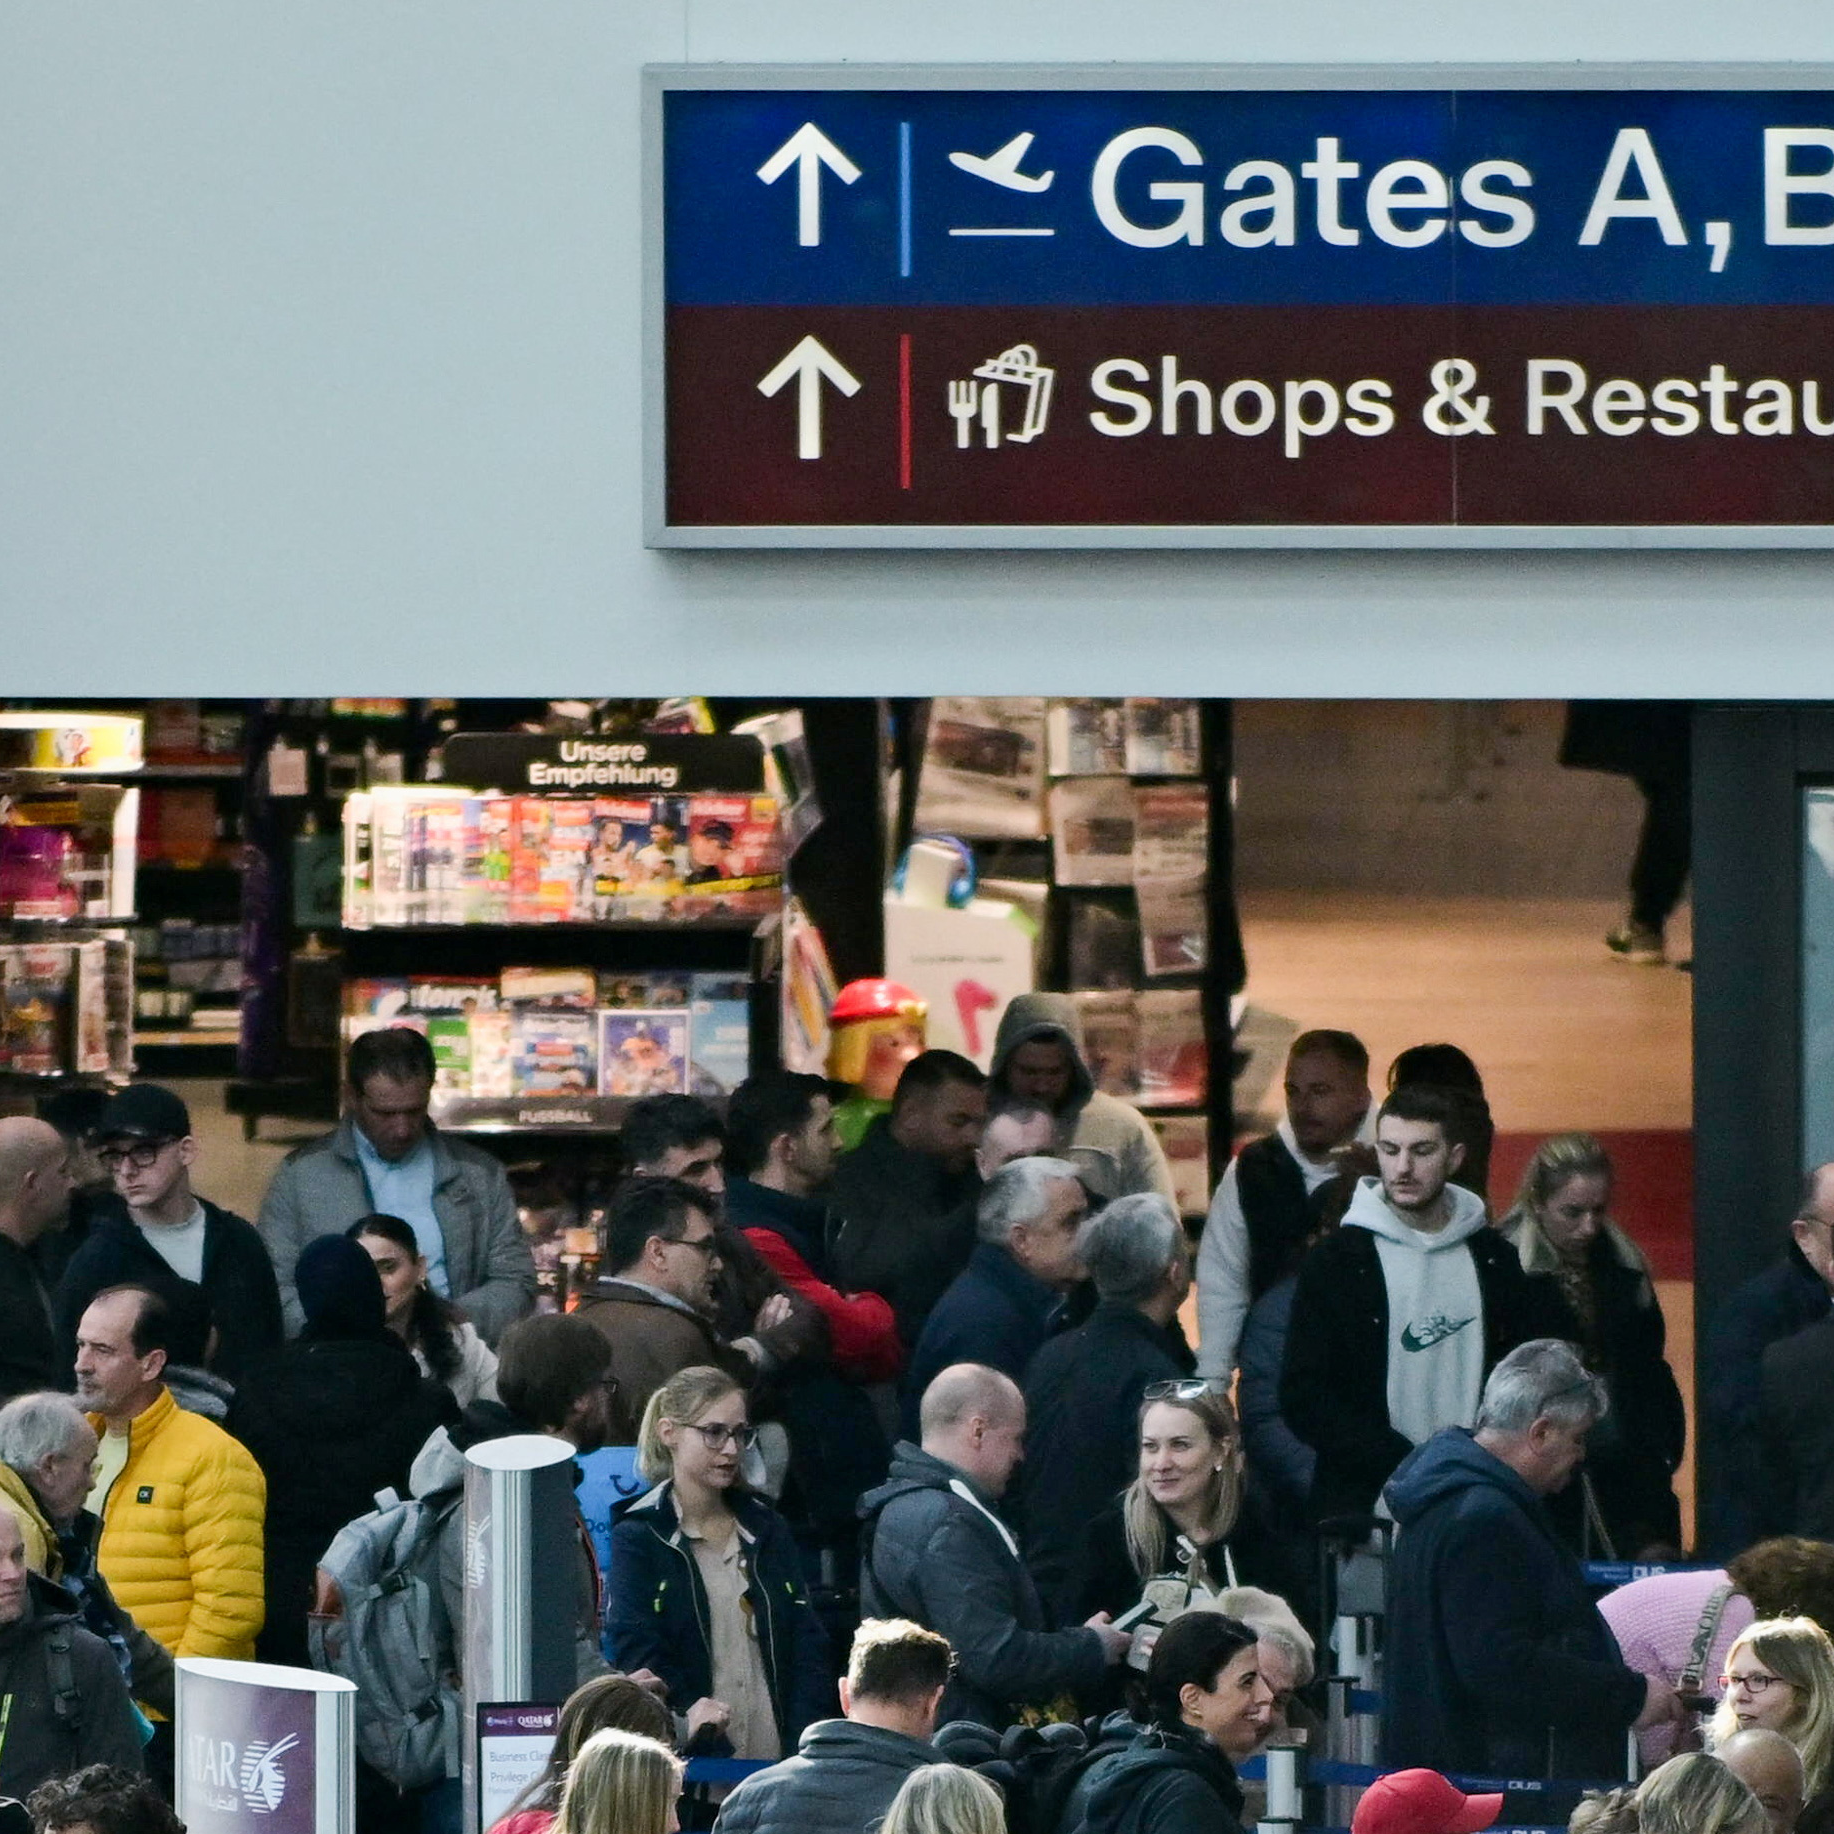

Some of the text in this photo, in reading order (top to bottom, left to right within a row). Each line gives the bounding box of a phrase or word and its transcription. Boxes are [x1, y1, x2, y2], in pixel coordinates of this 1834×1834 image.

[1091, 126, 1535, 249] Gates
[1088, 356, 1396, 459] Shops
[1421, 356, 1496, 437] &
[560, 741, 647, 762] Unsere
[529, 763, 679, 788] Empfehlung
[1632, 1564, 1666, 1581] DUS
[489, 1751, 528, 1764] Business
